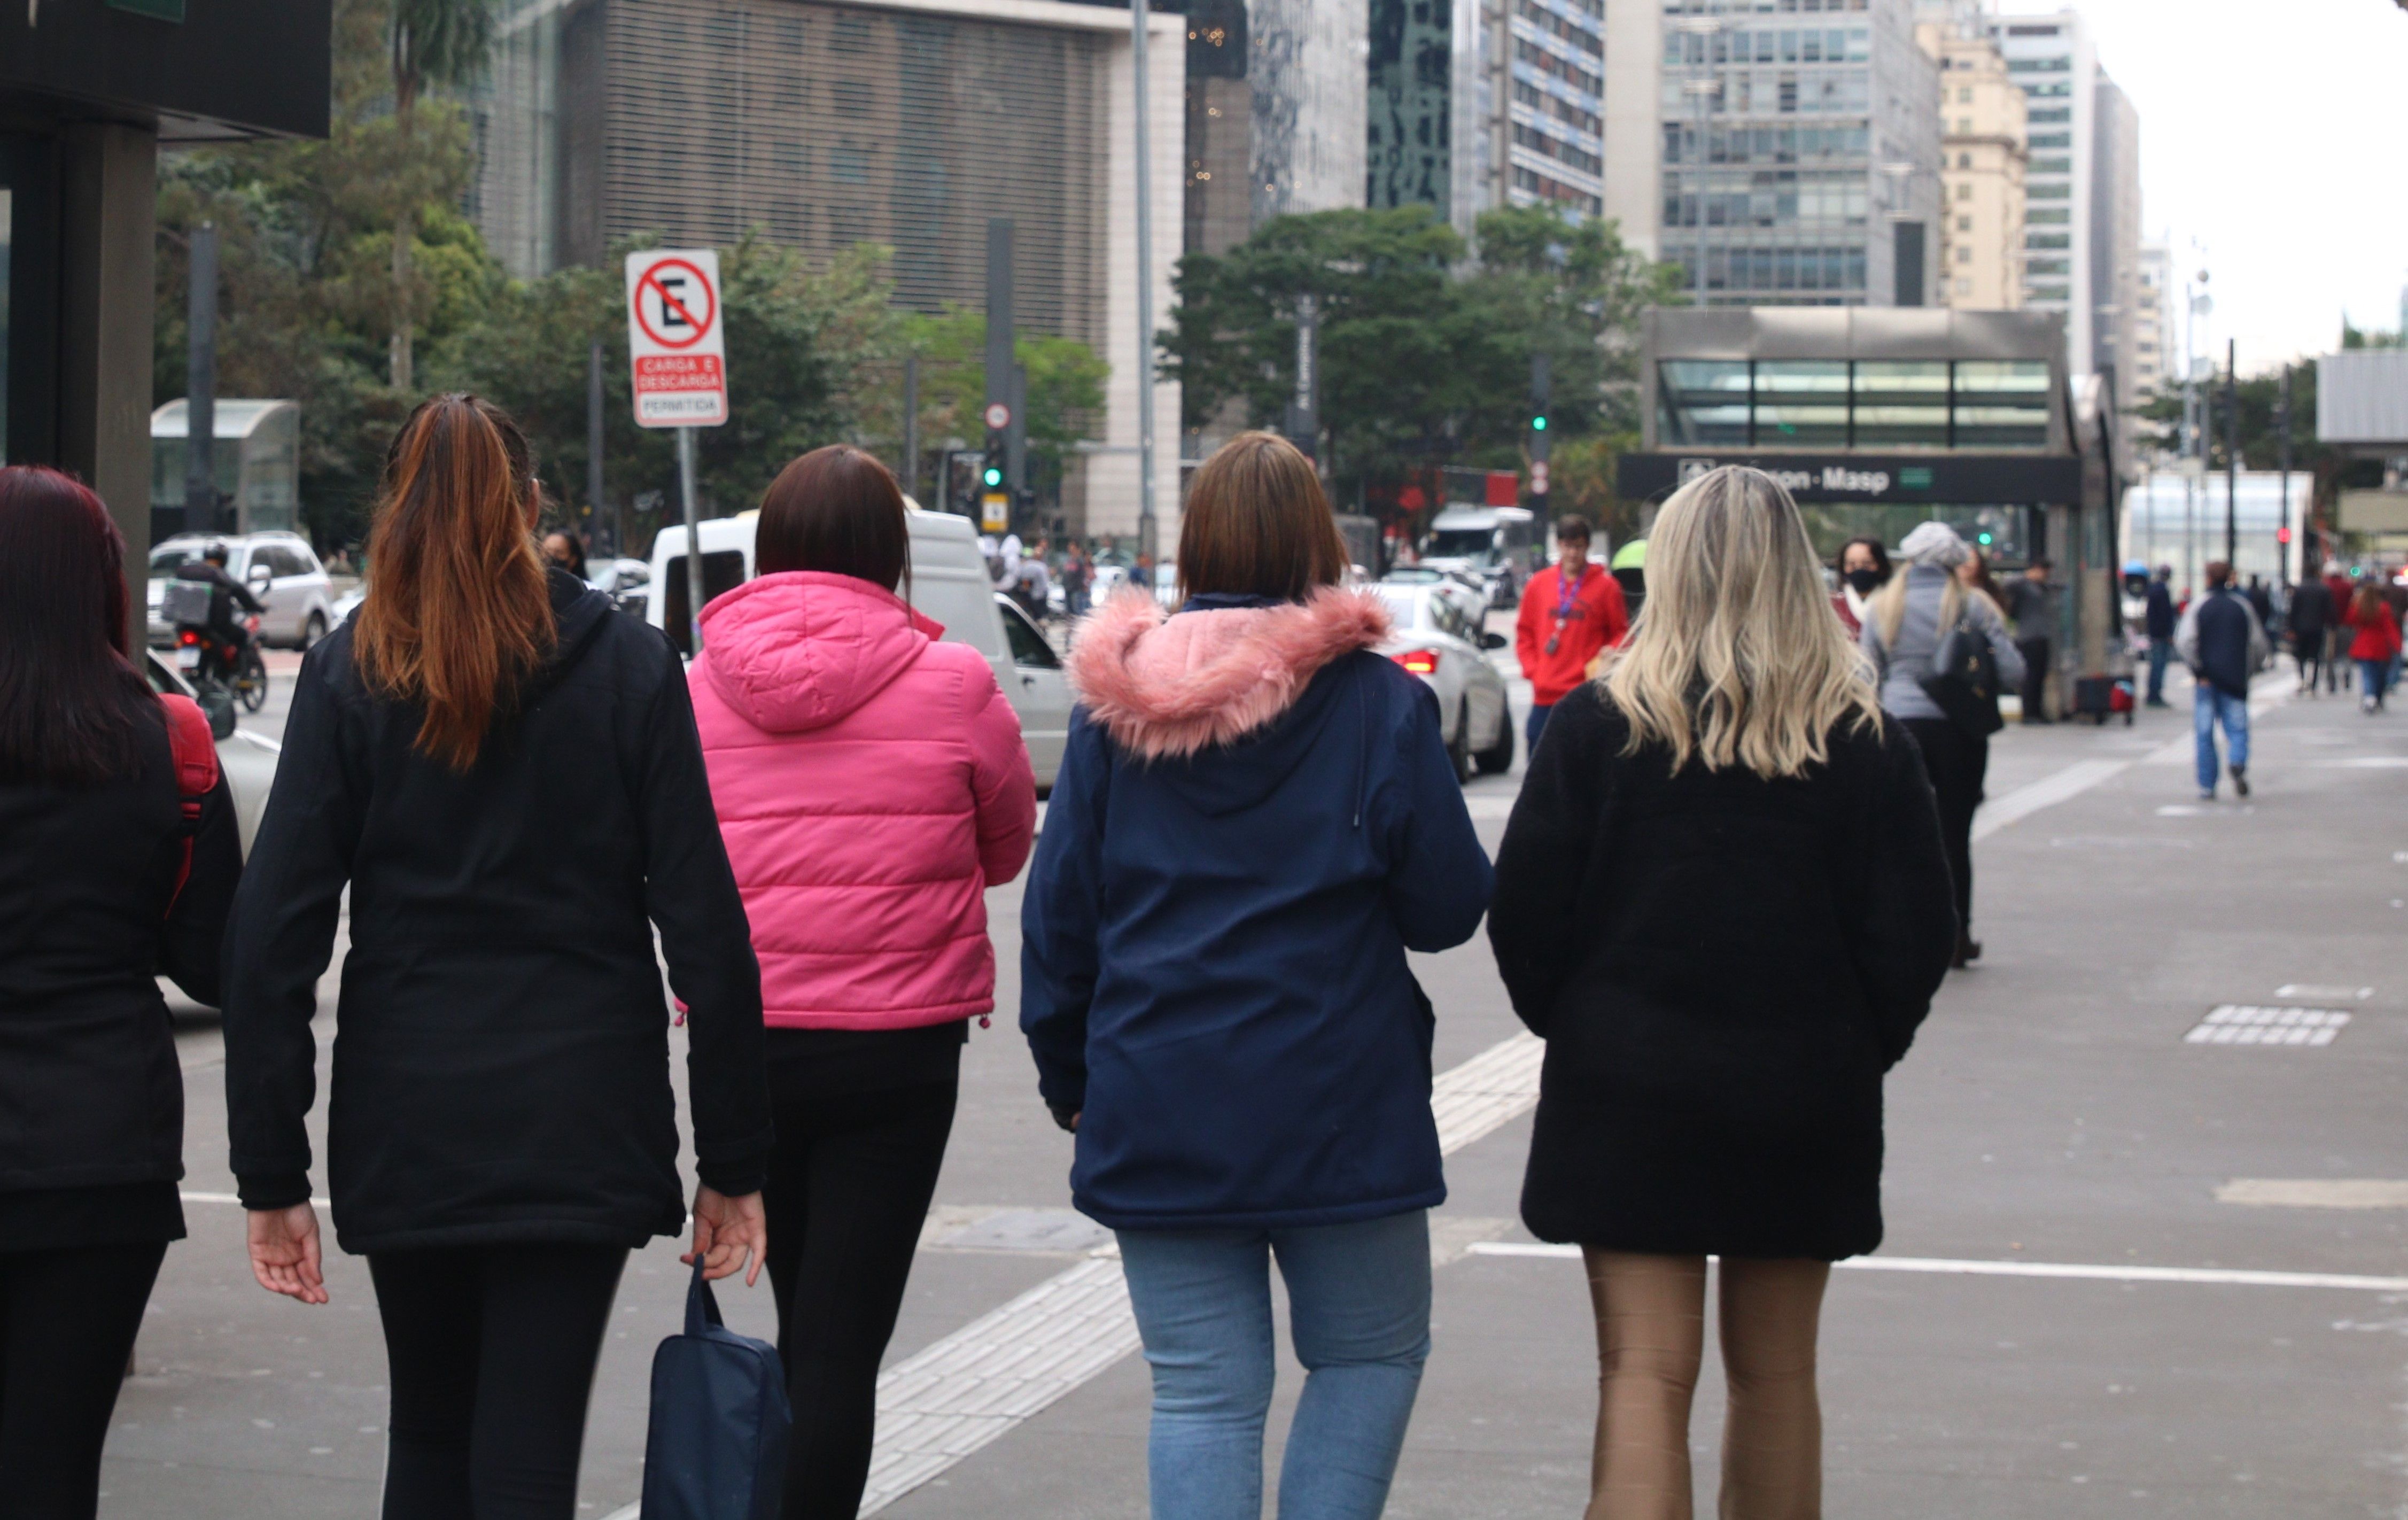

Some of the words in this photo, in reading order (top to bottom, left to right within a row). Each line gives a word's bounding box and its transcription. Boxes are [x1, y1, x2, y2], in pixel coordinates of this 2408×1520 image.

[643, 358, 697, 373] CARGA
[703, 356, 714, 371] E
[639, 374, 719, 390] DESCARGA
[643, 398, 717, 412] PERMITIDA
[1822, 467, 1890, 495] Masp
